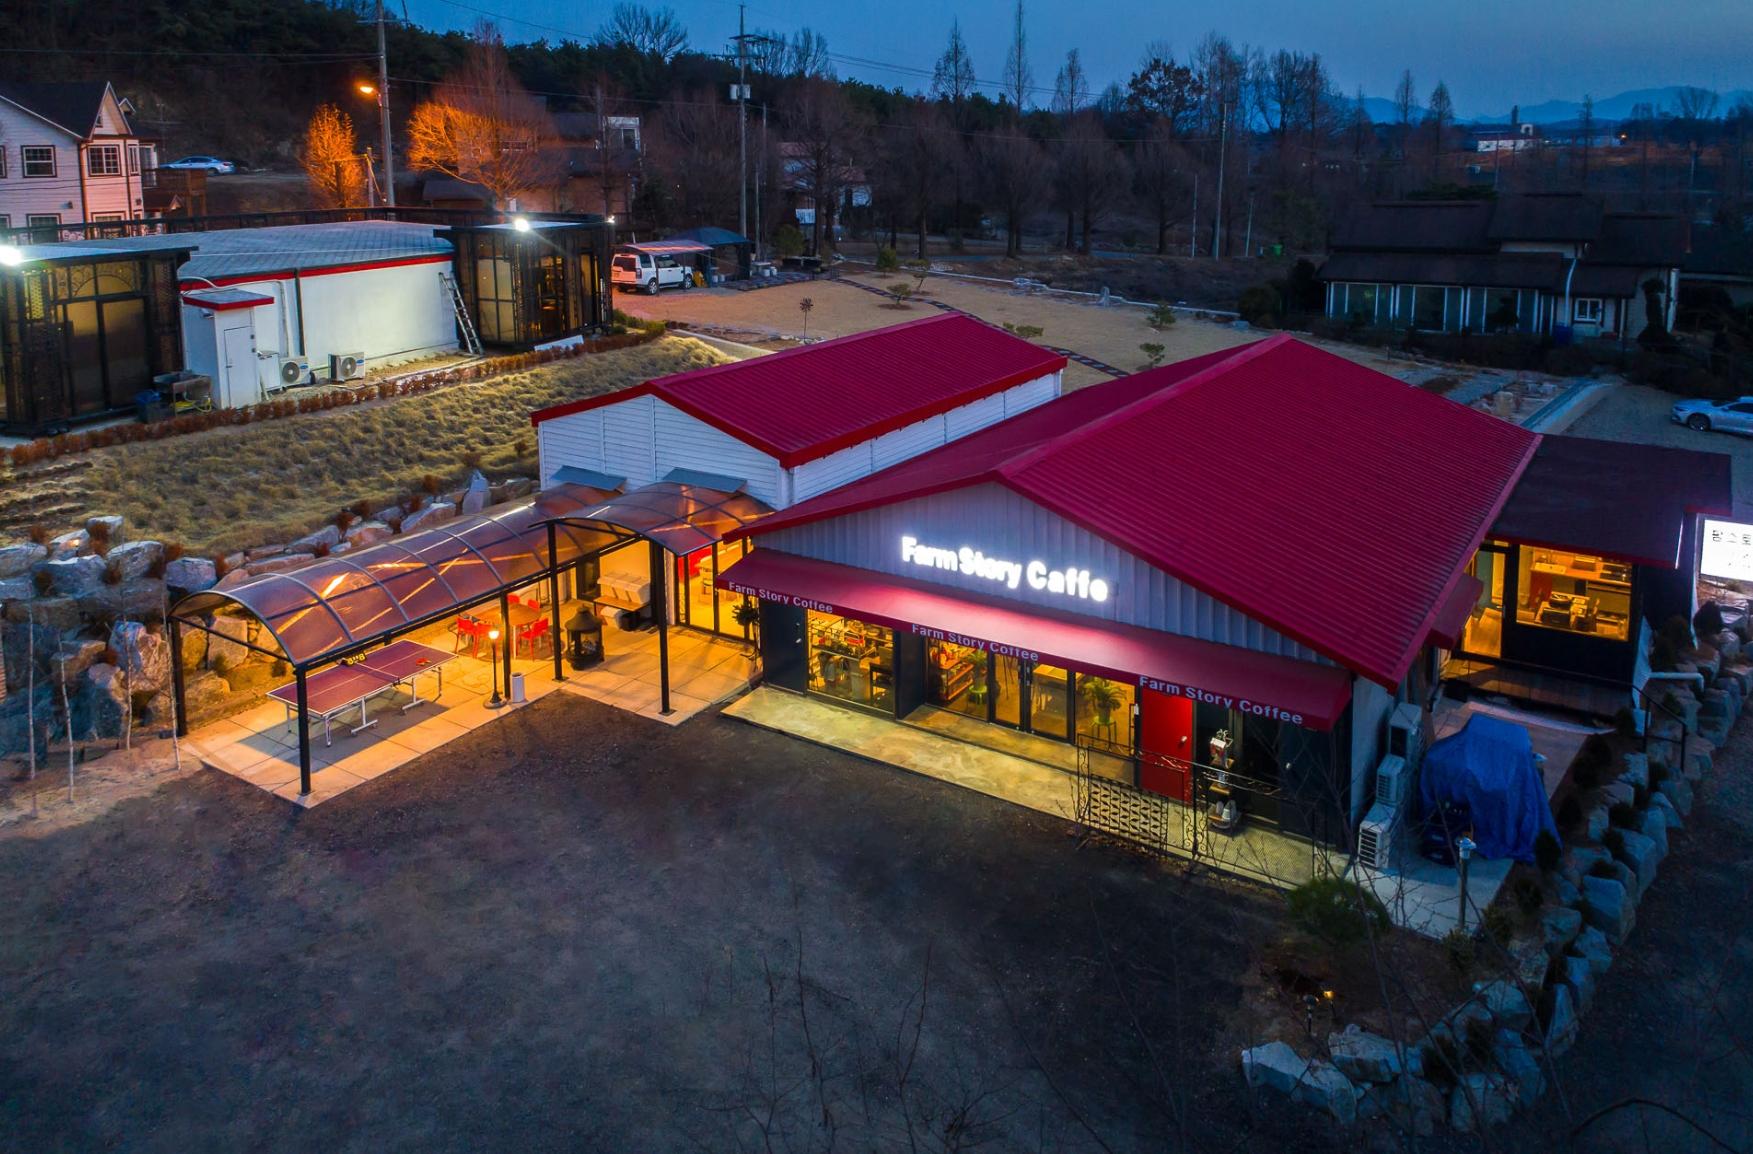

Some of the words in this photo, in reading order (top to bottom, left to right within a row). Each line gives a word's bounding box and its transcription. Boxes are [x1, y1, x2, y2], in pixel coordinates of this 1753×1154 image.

[902, 536, 958, 571] Farm
[959, 547, 1022, 589] Story
[728, 581, 756, 595] Farm
[759, 588, 790, 605] Story
[793, 596, 833, 614] Coffee
[911, 623, 944, 640] Farm
[948, 632, 985, 650] Story
[989, 642, 1039, 661] Coffee
[1139, 676, 1180, 695] Farm
[1185, 687, 1233, 709] Story
[1239, 700, 1303, 725] Coffee
